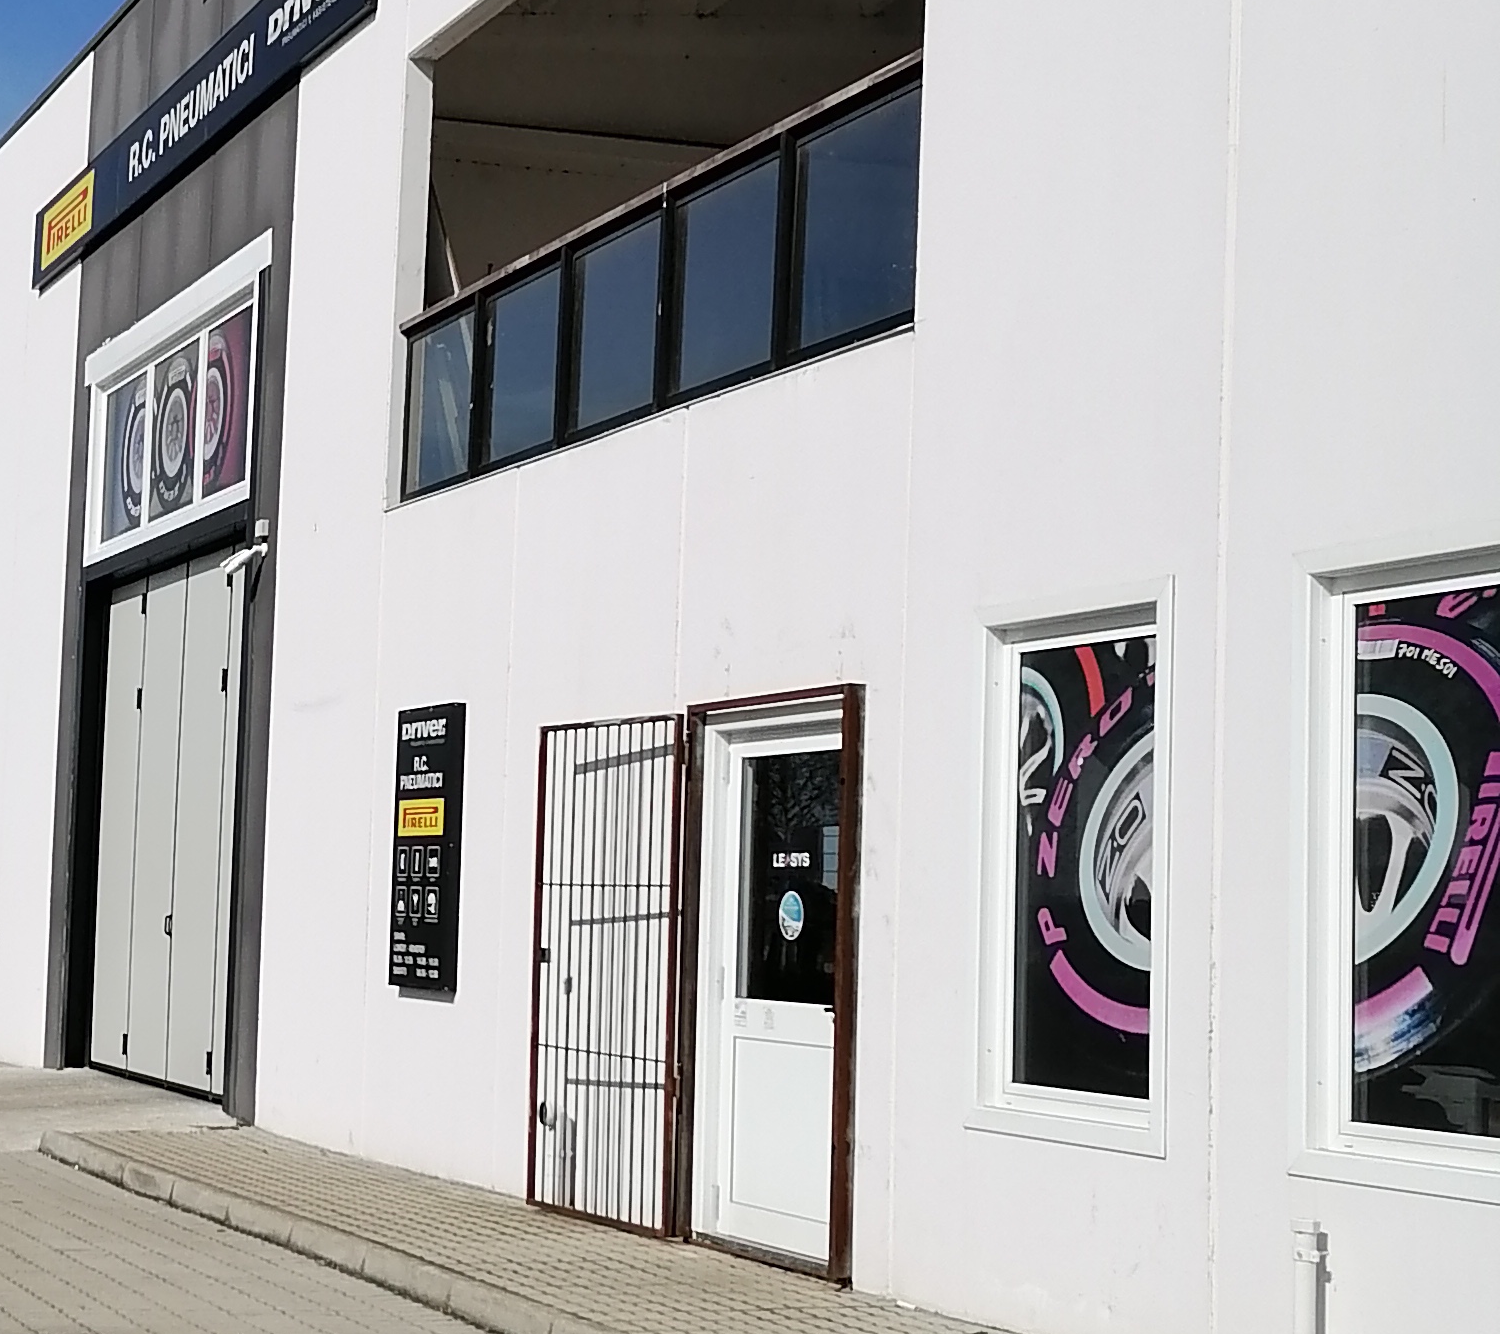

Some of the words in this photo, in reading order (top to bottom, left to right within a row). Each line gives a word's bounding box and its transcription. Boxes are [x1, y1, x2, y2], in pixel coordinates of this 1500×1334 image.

[128, 128, 156, 183] R.C.
[158, 32, 255, 156] PNEUMATICI
[46, 185, 89, 256] PIRELLI
[402, 806, 439, 829] PIRELLI
